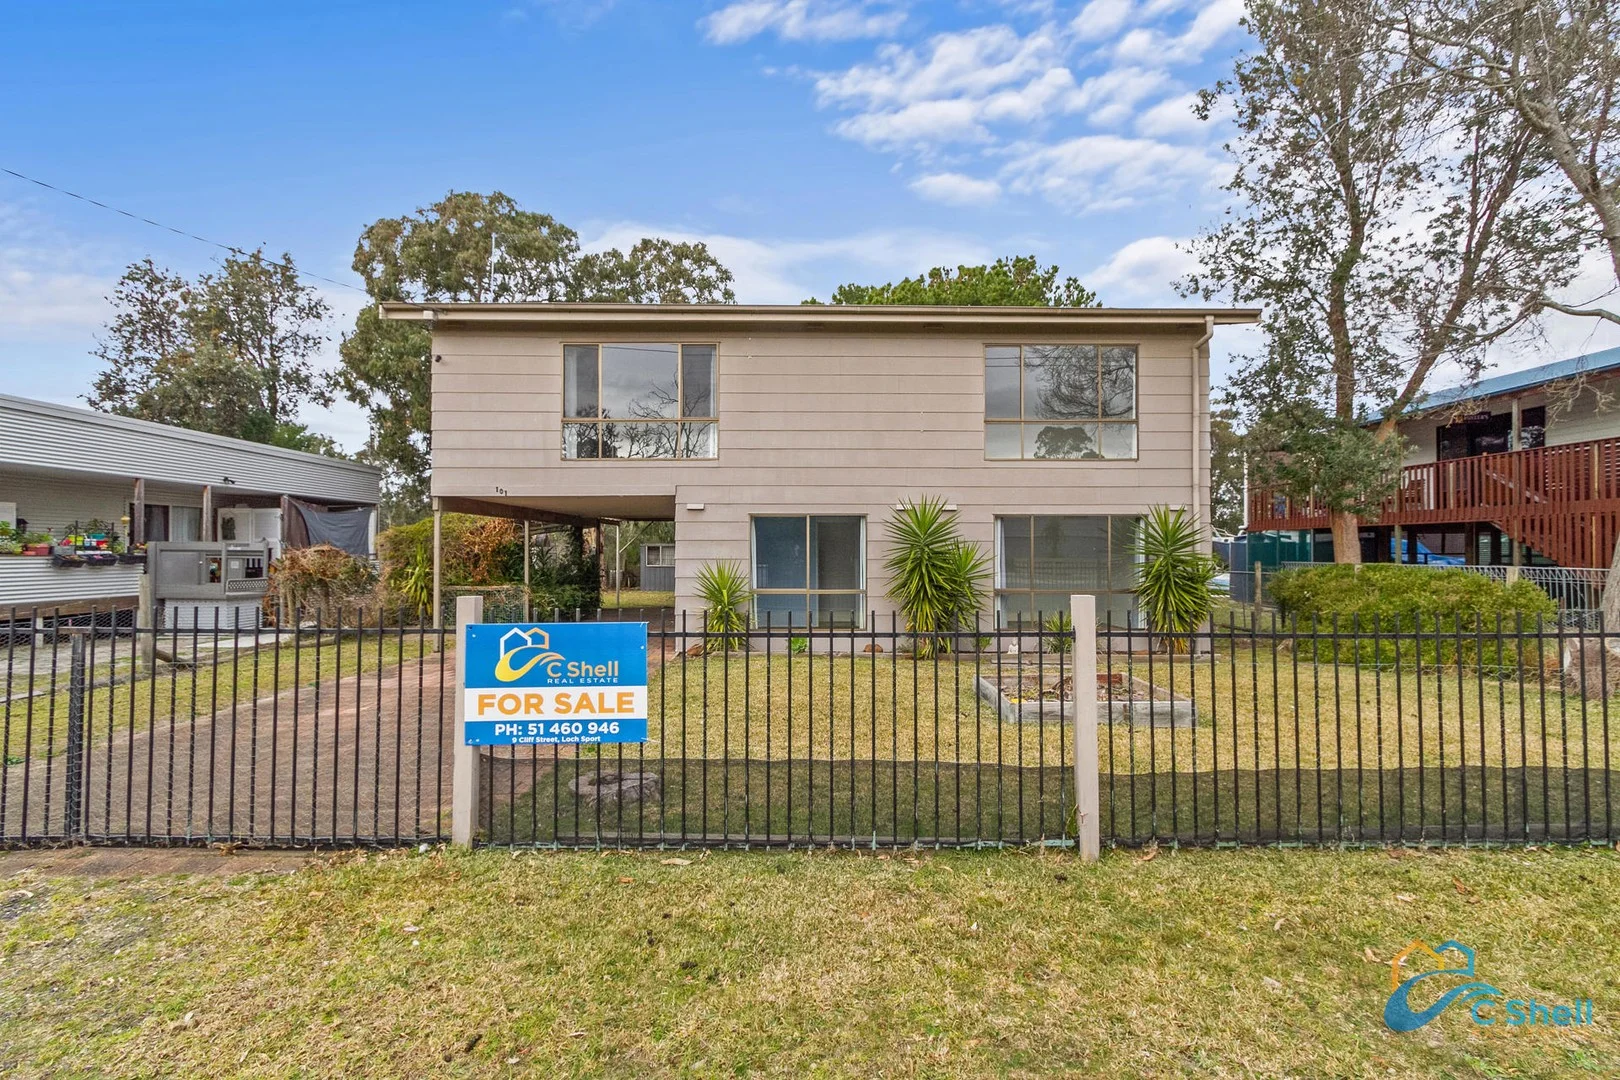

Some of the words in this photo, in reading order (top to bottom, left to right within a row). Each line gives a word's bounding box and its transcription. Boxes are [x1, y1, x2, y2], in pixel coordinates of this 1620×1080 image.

[547, 662, 562, 677] C
[567, 660, 619, 677] Shell
[478, 693, 544, 715] FOR
[554, 692, 634, 714] SALE
[495, 723, 522, 736] PH:
[528, 723, 544, 735] 51
[549, 722, 583, 735] 460
[588, 721, 620, 734] 946
[536, 736, 560, 744] Street,
[561, 735, 580, 743] Loch
[581, 735, 601, 744] Sport
